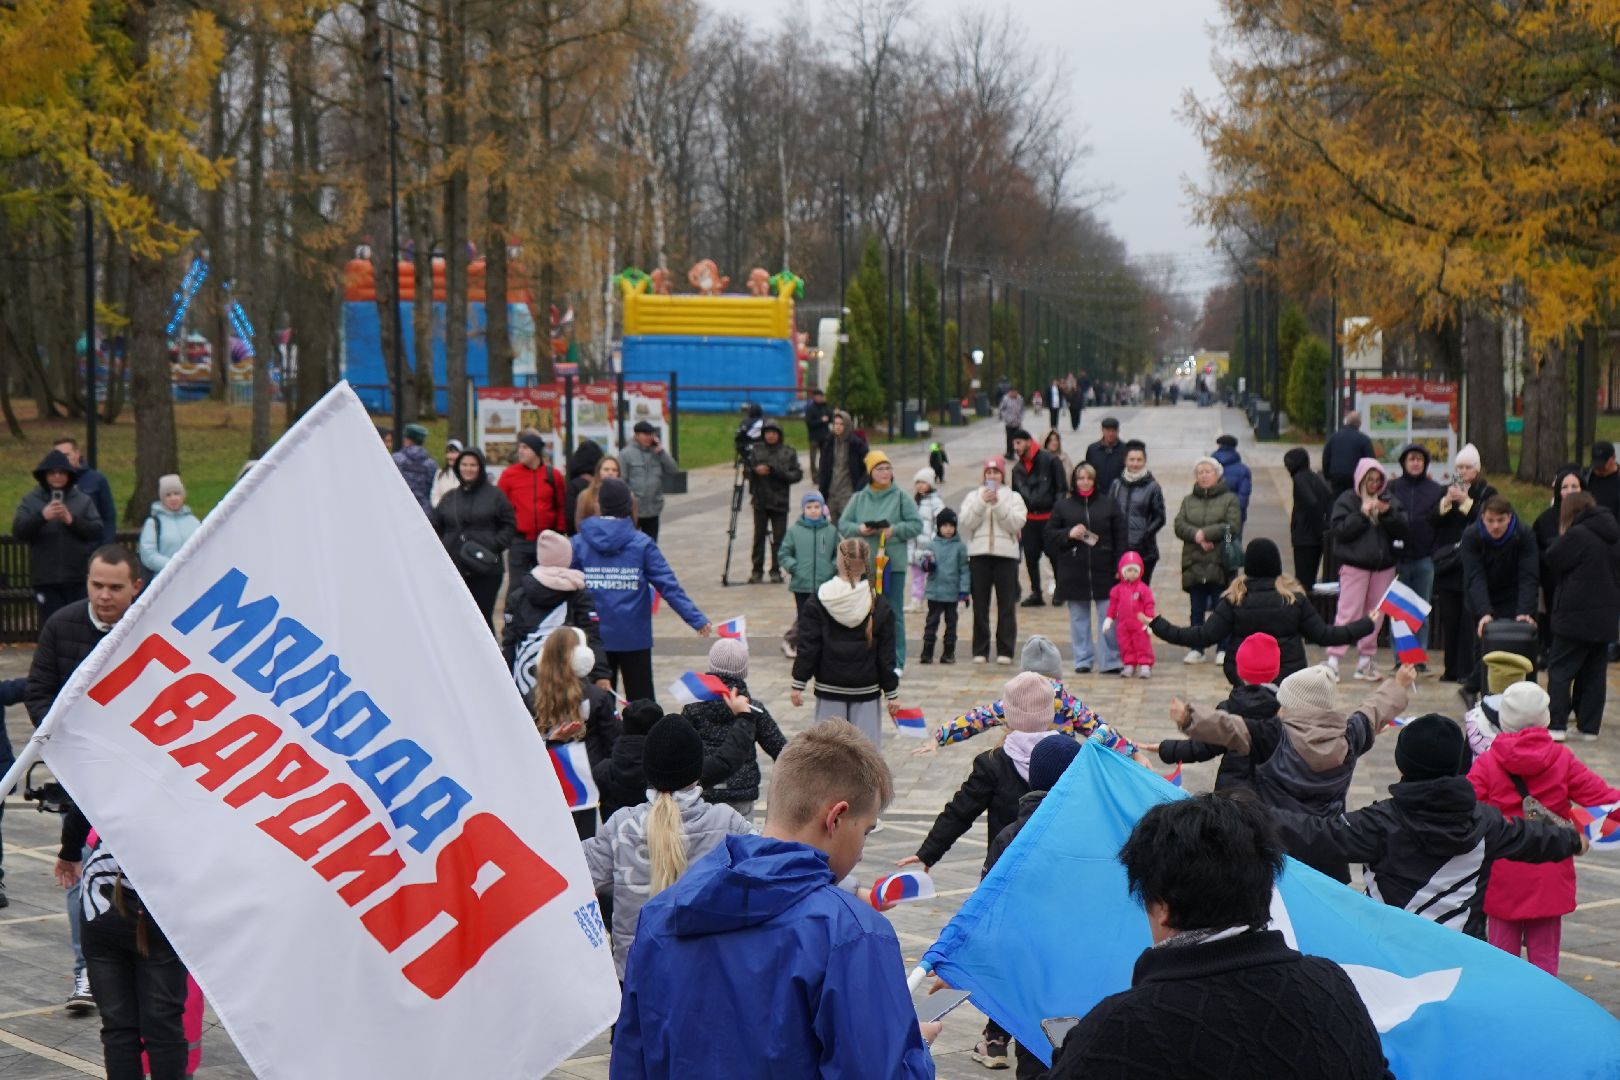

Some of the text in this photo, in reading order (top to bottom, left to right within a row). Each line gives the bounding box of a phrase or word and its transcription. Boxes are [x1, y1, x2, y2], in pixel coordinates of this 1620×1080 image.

[585, 580, 639, 590] ОТЧИЗНЕ
[87, 634, 568, 999] ГВАРДИЯ
[574, 910, 599, 949] РОССИЯ
